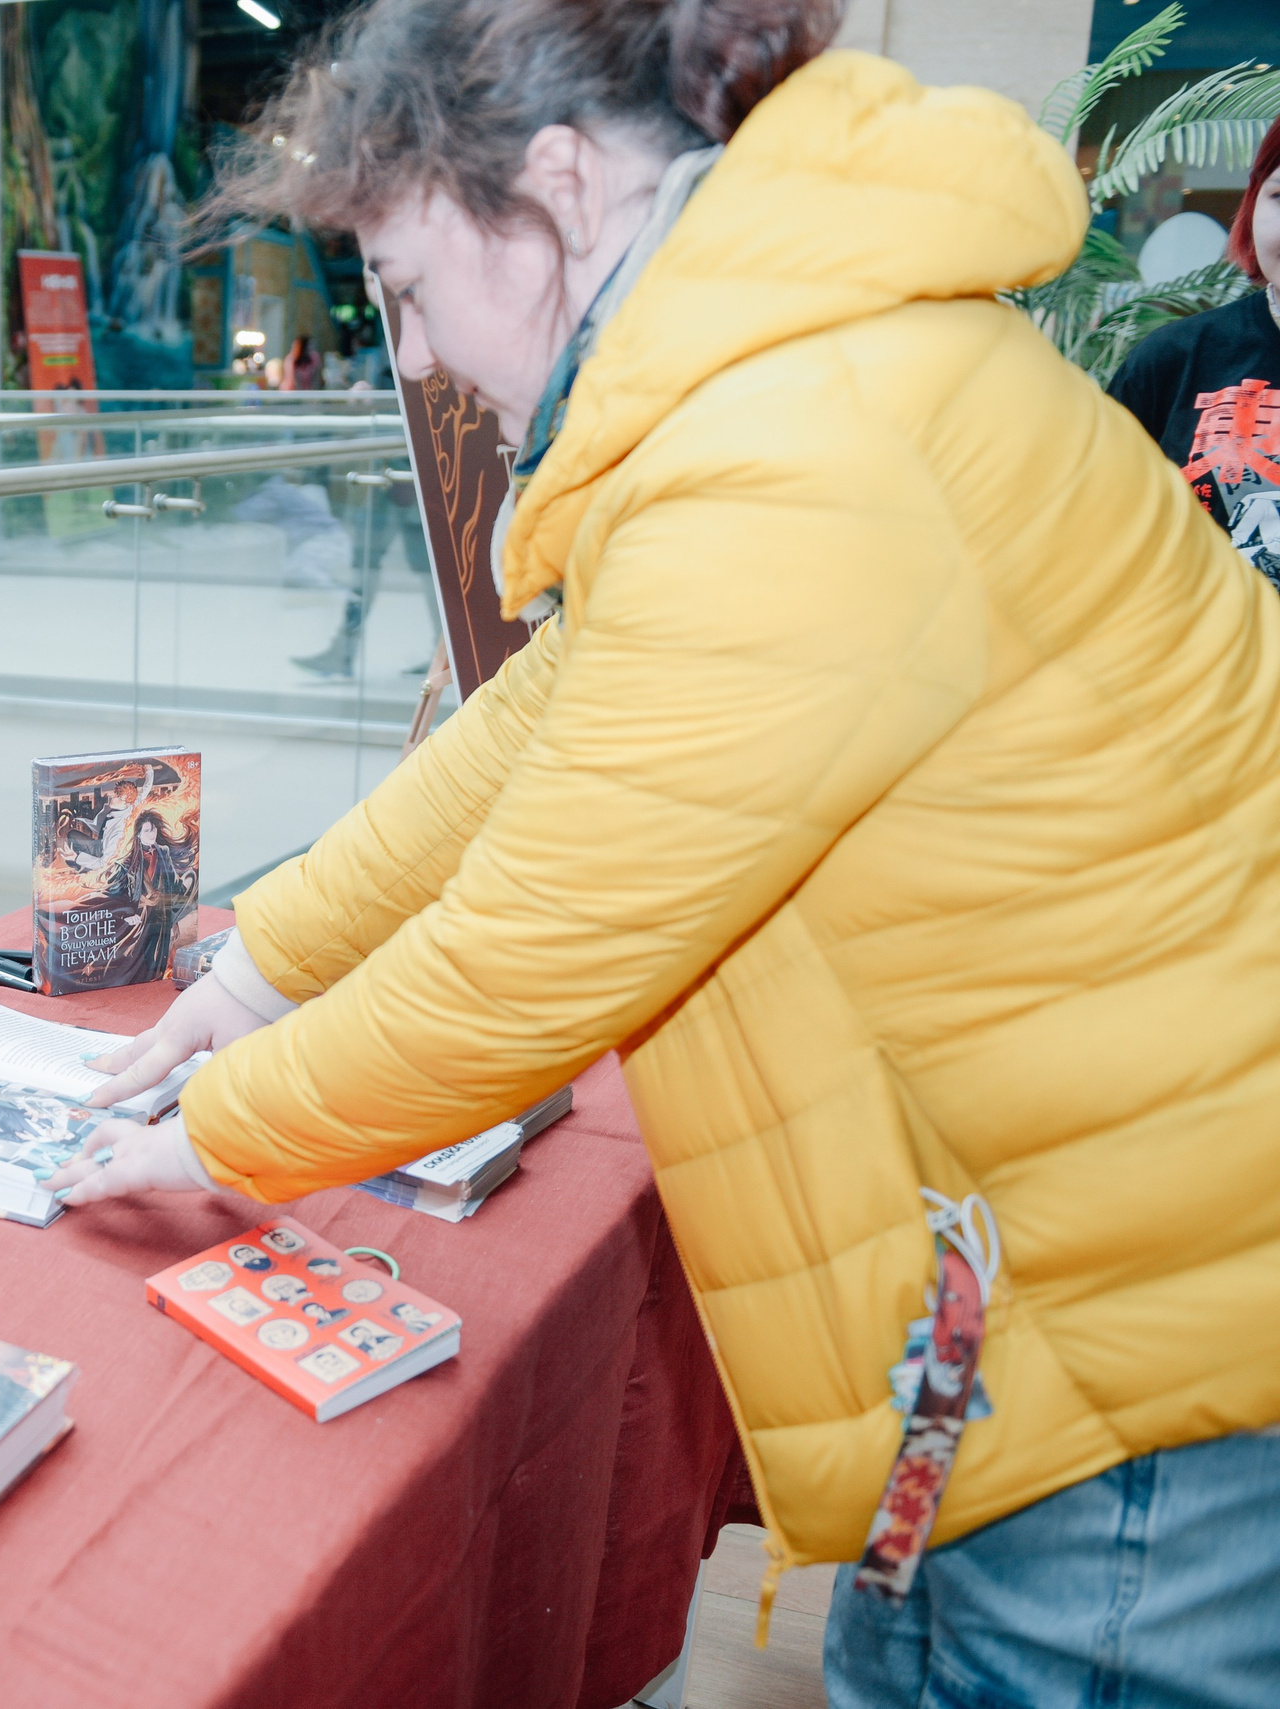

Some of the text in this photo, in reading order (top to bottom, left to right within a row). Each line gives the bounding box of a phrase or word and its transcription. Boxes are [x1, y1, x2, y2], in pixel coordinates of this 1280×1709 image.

[186, 760, 199, 769] 18+
[60, 919, 116, 942] В ОГНЕ
[61, 937, 117, 952] бушующем
[61, 945, 117, 968] ПЕЧАЛИ
